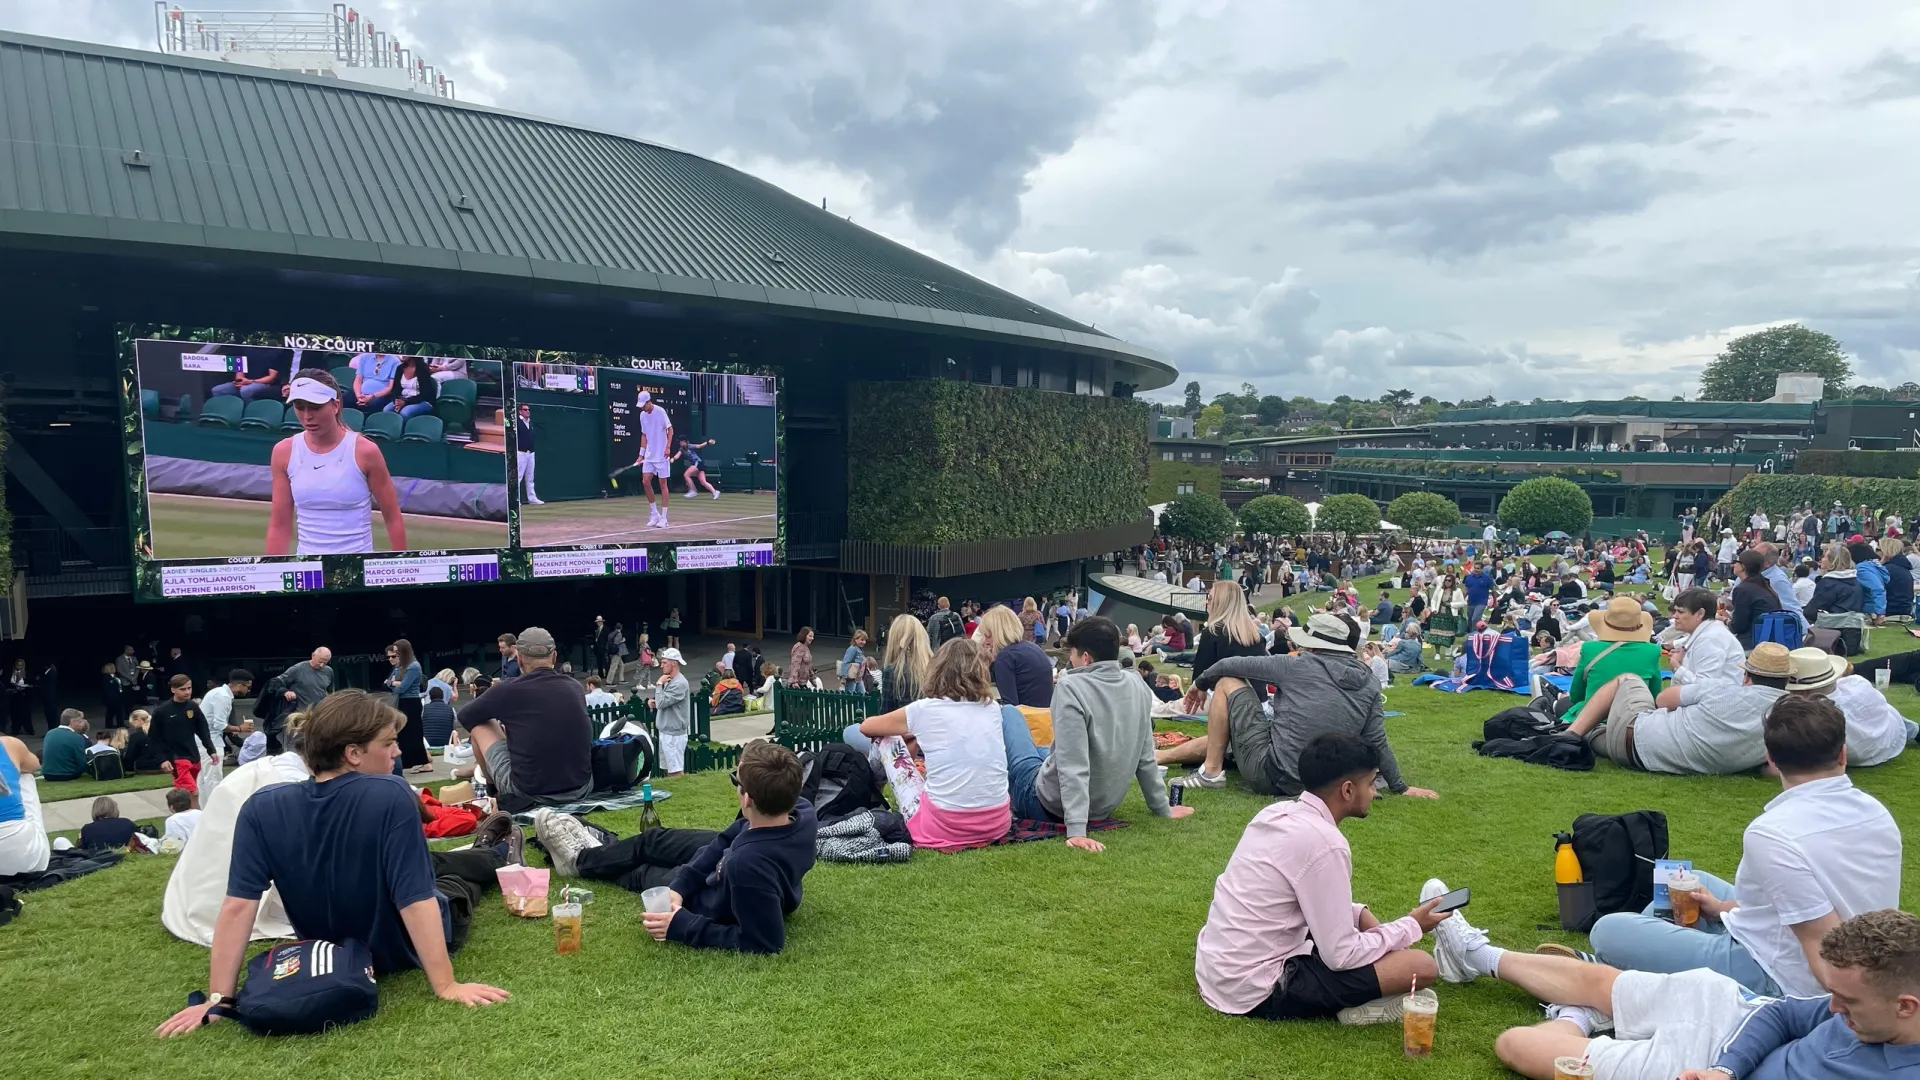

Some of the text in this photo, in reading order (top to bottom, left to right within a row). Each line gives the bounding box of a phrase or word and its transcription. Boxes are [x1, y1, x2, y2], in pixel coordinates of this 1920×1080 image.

[284, 336, 374, 352] NO.2 COURT
[631, 359, 681, 371] COURT 12
[163, 577, 186, 585] AJLA
[188, 576, 247, 584] TOMLJANOVIC
[164, 586, 211, 595] CATHERINE
